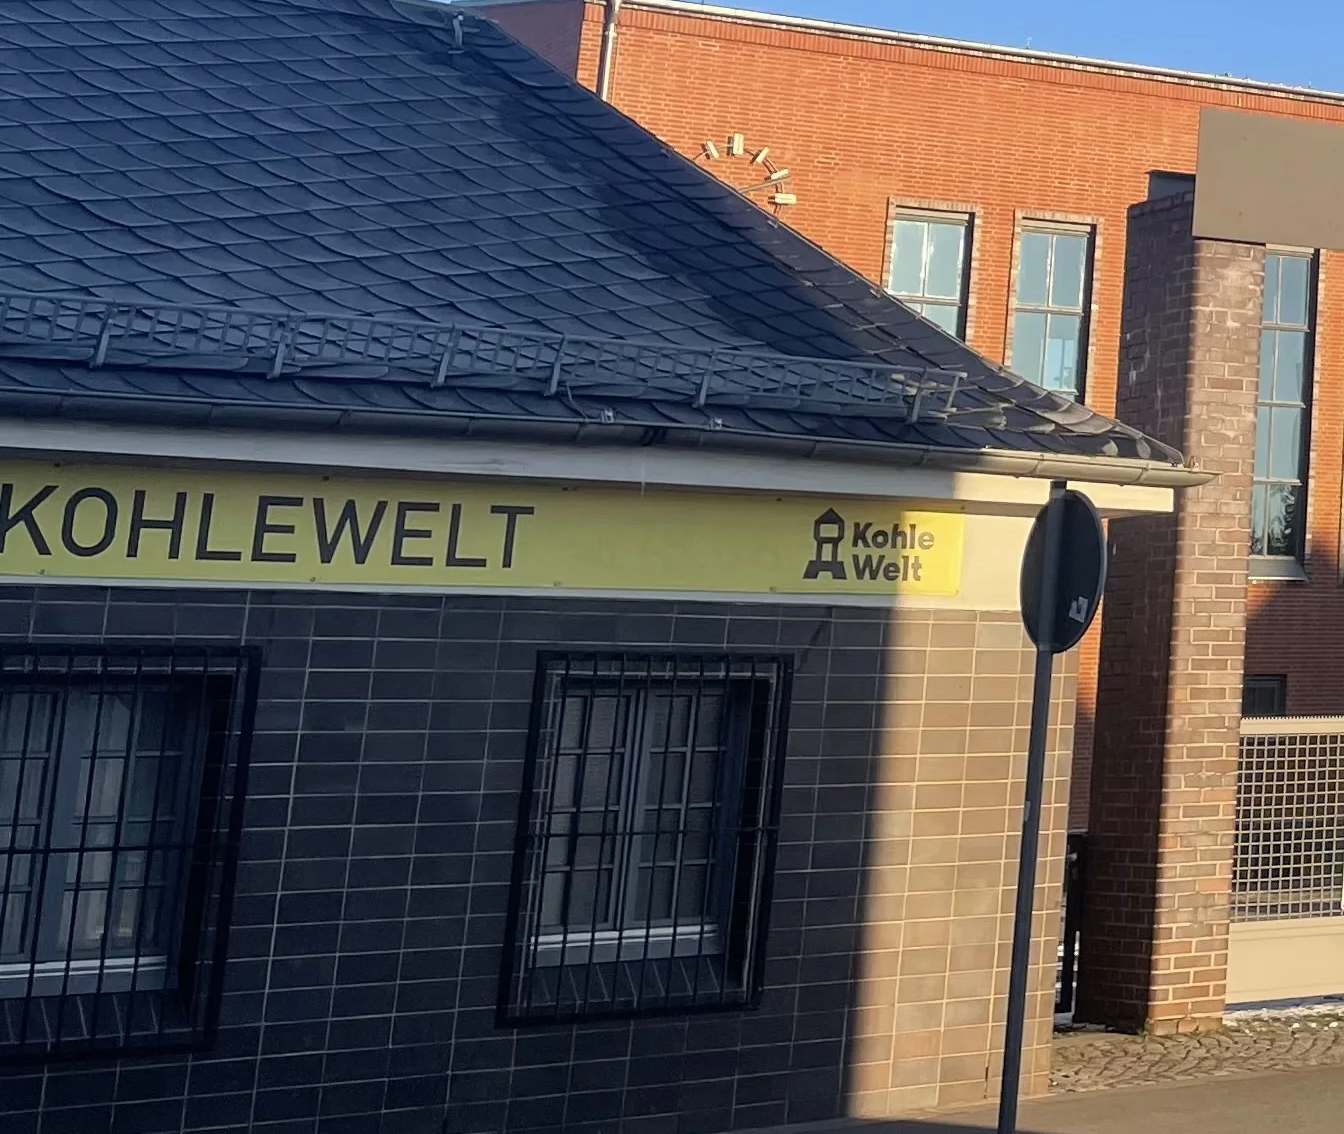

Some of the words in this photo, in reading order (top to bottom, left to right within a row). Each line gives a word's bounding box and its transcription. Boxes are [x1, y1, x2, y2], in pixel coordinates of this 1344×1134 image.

[0, 482, 535, 569] KOHLEWELT
[852, 522, 935, 550] Kohle
[852, 554, 922, 582] Welt
